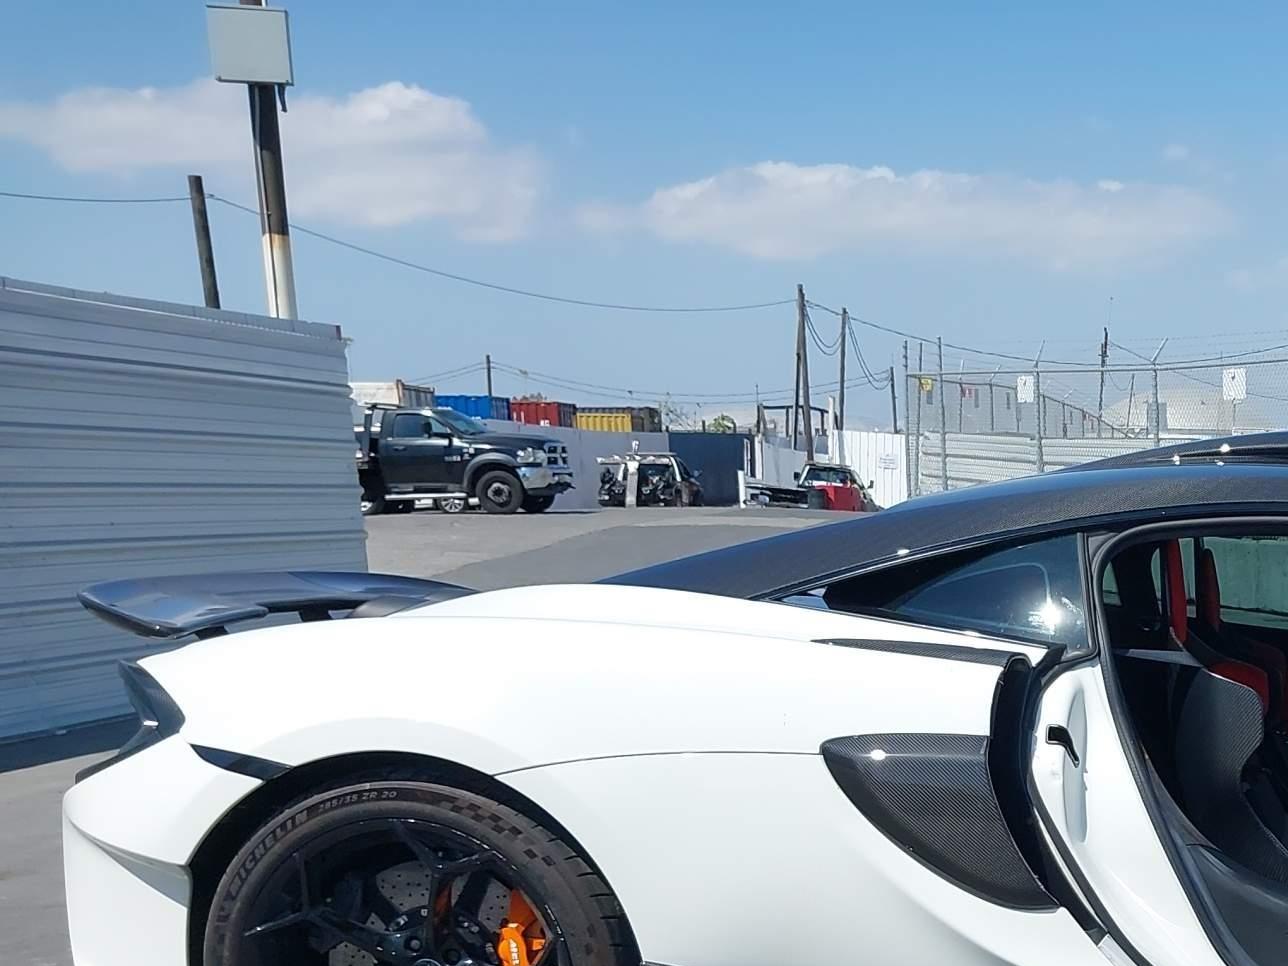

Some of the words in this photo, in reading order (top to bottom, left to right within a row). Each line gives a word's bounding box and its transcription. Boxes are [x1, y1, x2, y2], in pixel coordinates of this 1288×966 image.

[229, 808, 310, 901] MICHELIN
[362, 791, 378, 800] ZR
[381, 790, 397, 799] 20
